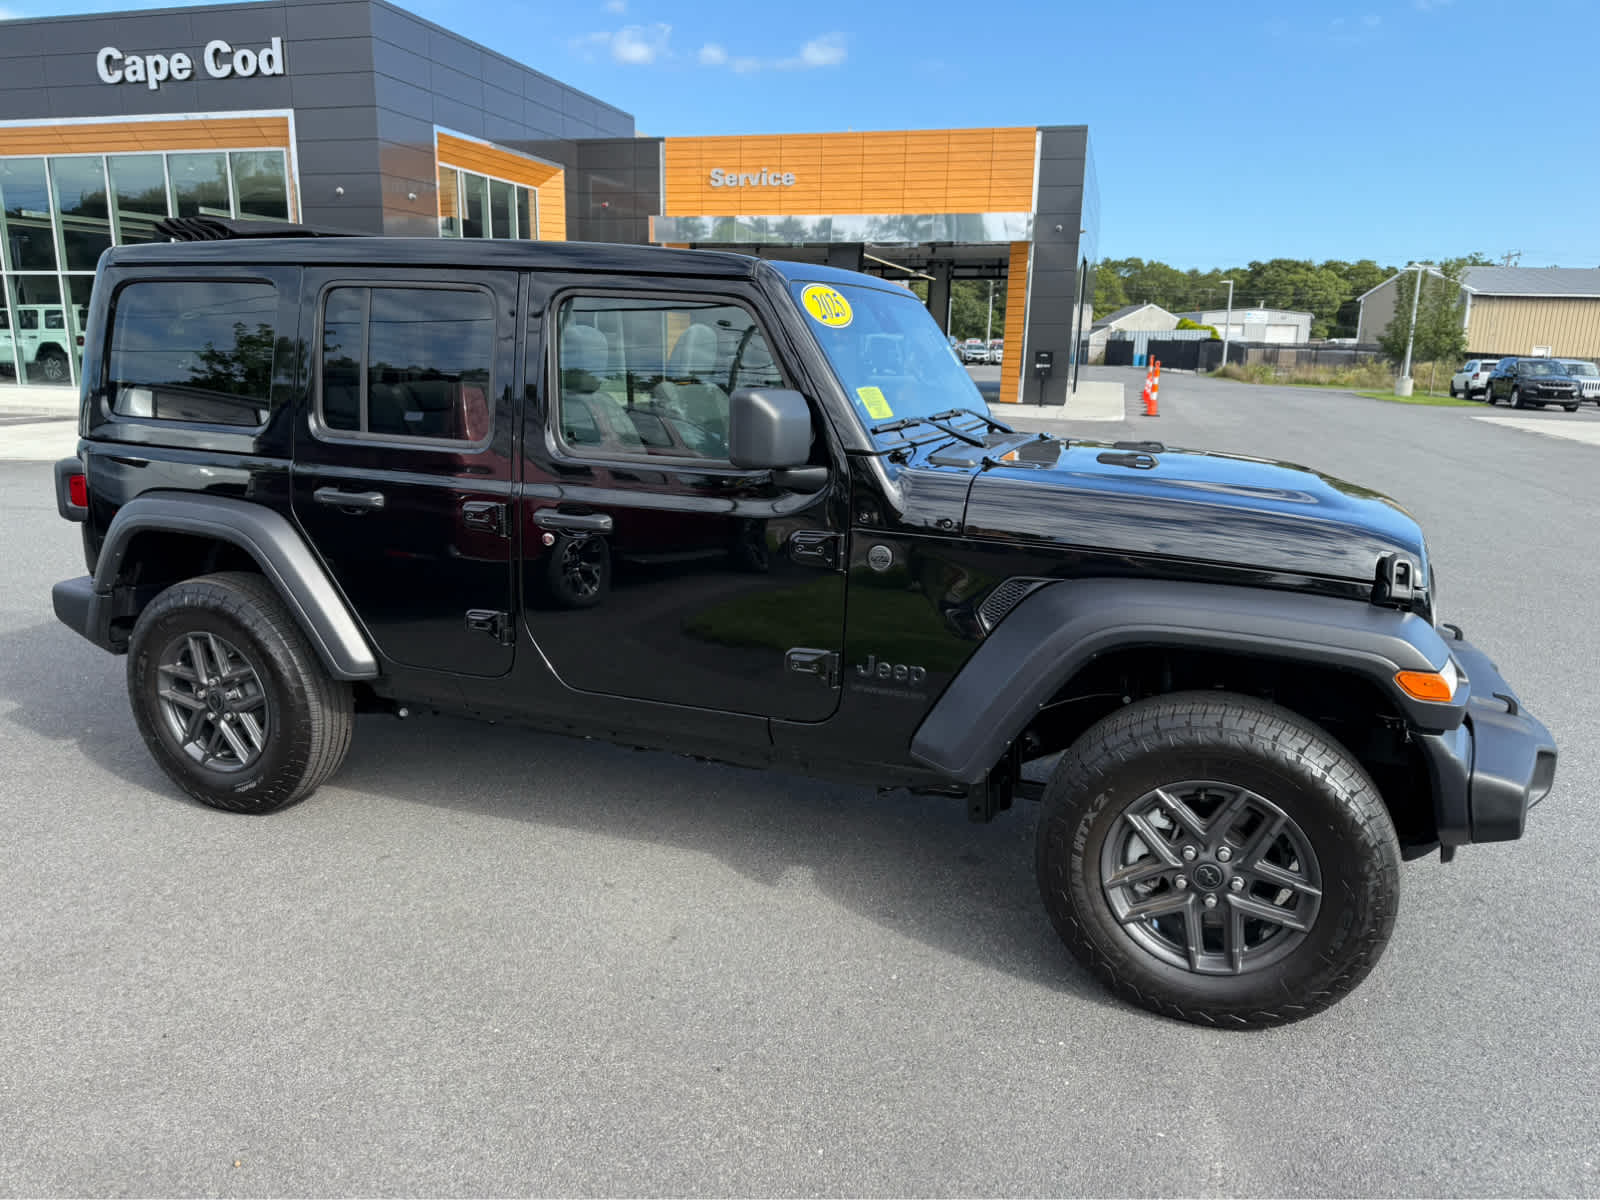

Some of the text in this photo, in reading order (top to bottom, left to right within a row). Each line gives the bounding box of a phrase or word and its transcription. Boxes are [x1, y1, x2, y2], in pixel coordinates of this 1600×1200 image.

[96, 36, 286, 90] Cape Cod
[710, 167, 796, 187] Service
[811, 292, 846, 319] 2025
[855, 655, 928, 682] Jeep
